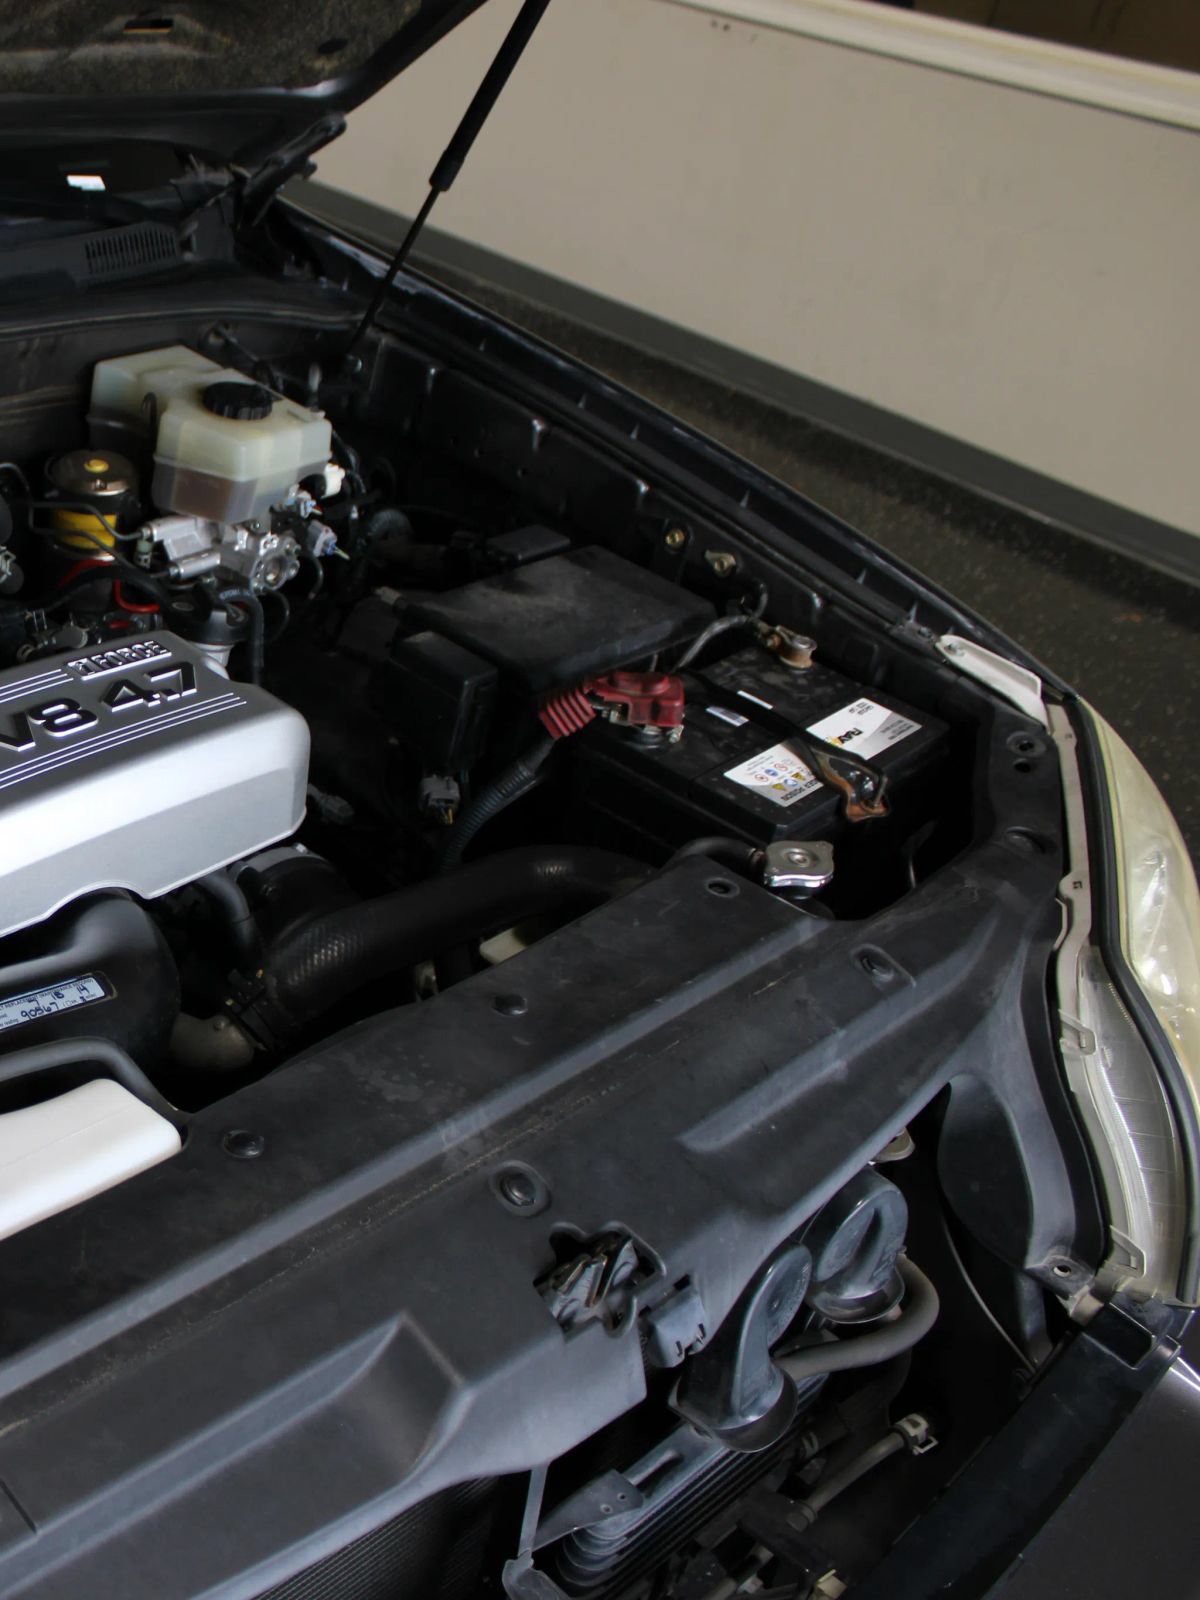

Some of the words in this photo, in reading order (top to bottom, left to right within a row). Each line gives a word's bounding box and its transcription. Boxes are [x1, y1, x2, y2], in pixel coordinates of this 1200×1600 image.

[101, 661, 198, 712] 4.7
[76, 983, 90, 995] 14
[20, 1001, 59, 1019] 90567
